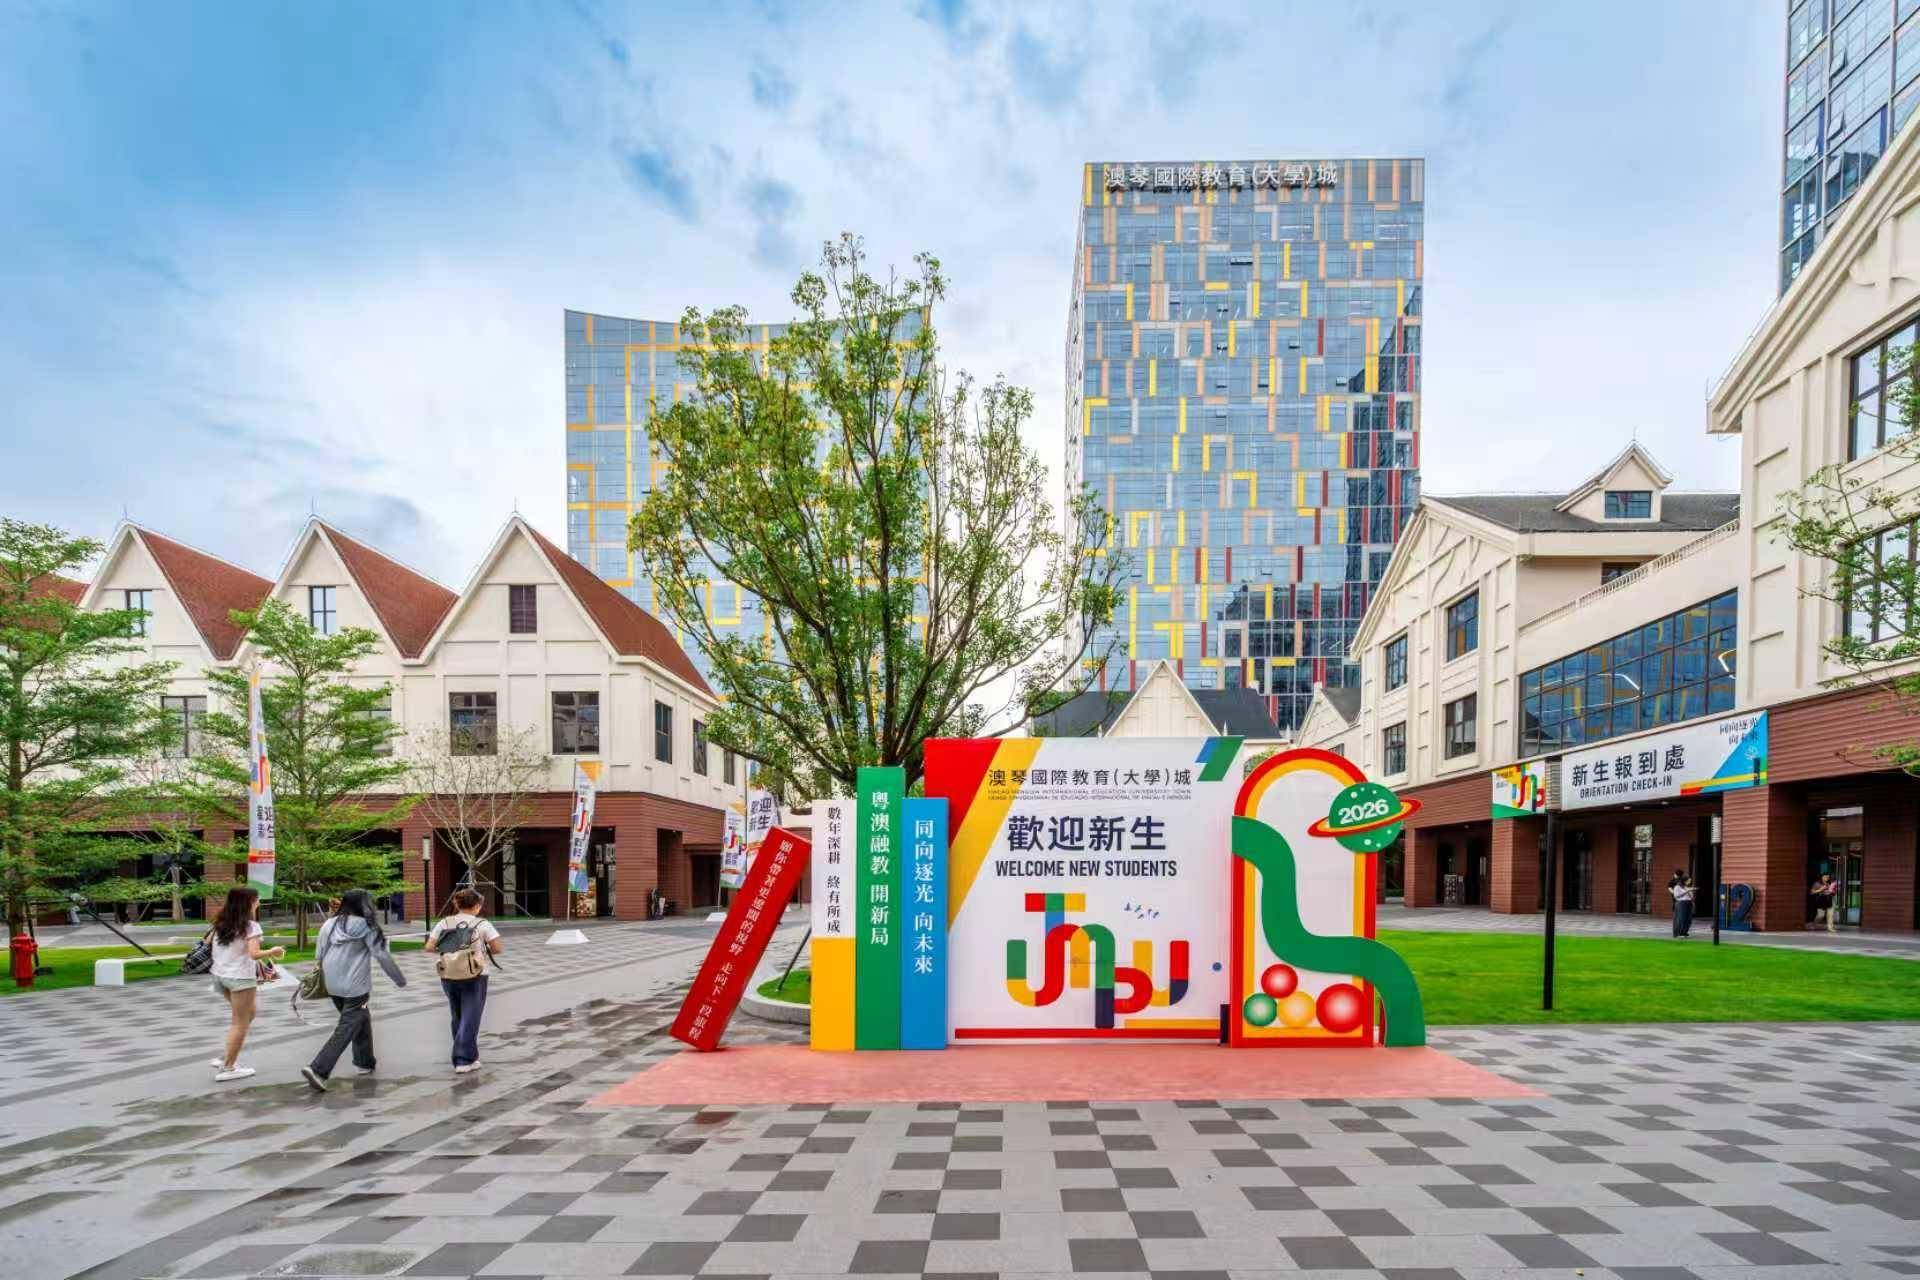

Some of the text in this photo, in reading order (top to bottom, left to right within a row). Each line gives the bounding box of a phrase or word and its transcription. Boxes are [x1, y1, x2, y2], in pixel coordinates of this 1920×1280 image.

[989, 769, 1192, 786] 澳琴國際教育(大學)城
[1572, 745, 1685, 787] 新生報到處
[1580, 774, 1672, 799] ORIENTATION CHECK-IN
[1338, 799, 1390, 824] 2026
[1007, 815, 1166, 851] 歡迎新生
[827, 807, 841, 934] 數年深耕 終有所成
[995, 860, 1177, 876] WELCOME NEW STUDENTS
[914, 819, 934, 974] 同向逐光 向未來
[870, 884, 889, 946] 開新局
